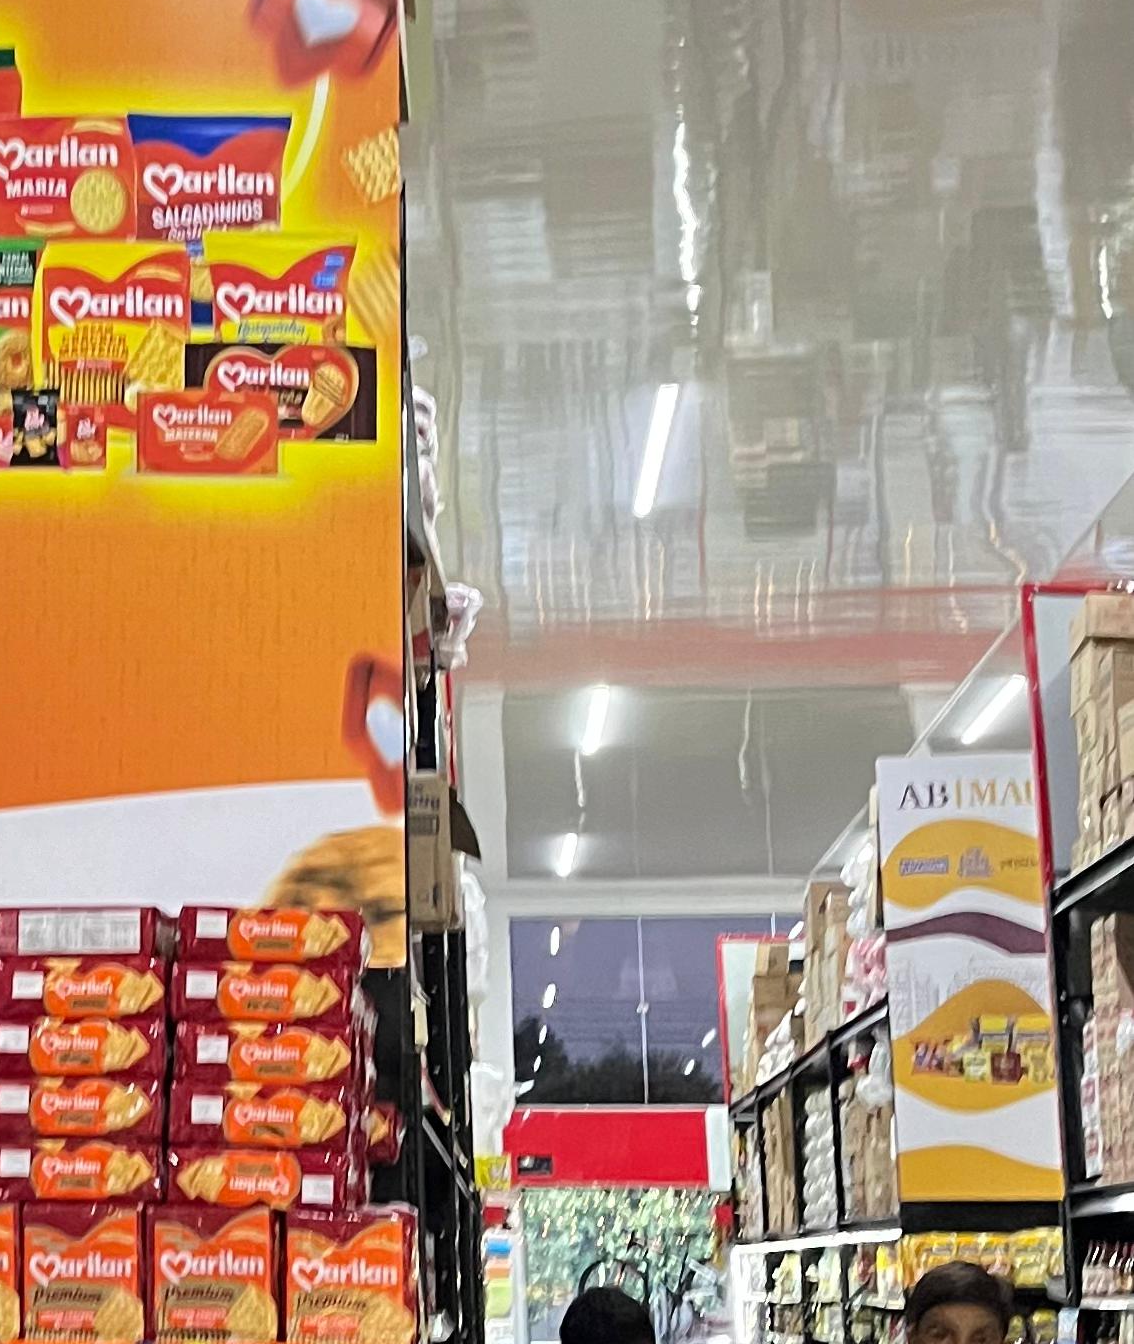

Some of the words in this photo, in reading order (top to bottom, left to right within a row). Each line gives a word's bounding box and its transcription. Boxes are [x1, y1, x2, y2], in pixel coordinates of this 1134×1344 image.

[5, 178, 67, 199] MARIA
[143, 163, 275, 204] Marilan
[50, 285, 184, 328] Marilan
[216, 281, 343, 324] Marilan
[218, 362, 310, 393] Marilan
[29, 1251, 132, 1286] Marilan
[160, 1248, 264, 1284] Marilan
[292, 1256, 398, 1292] Marilan
